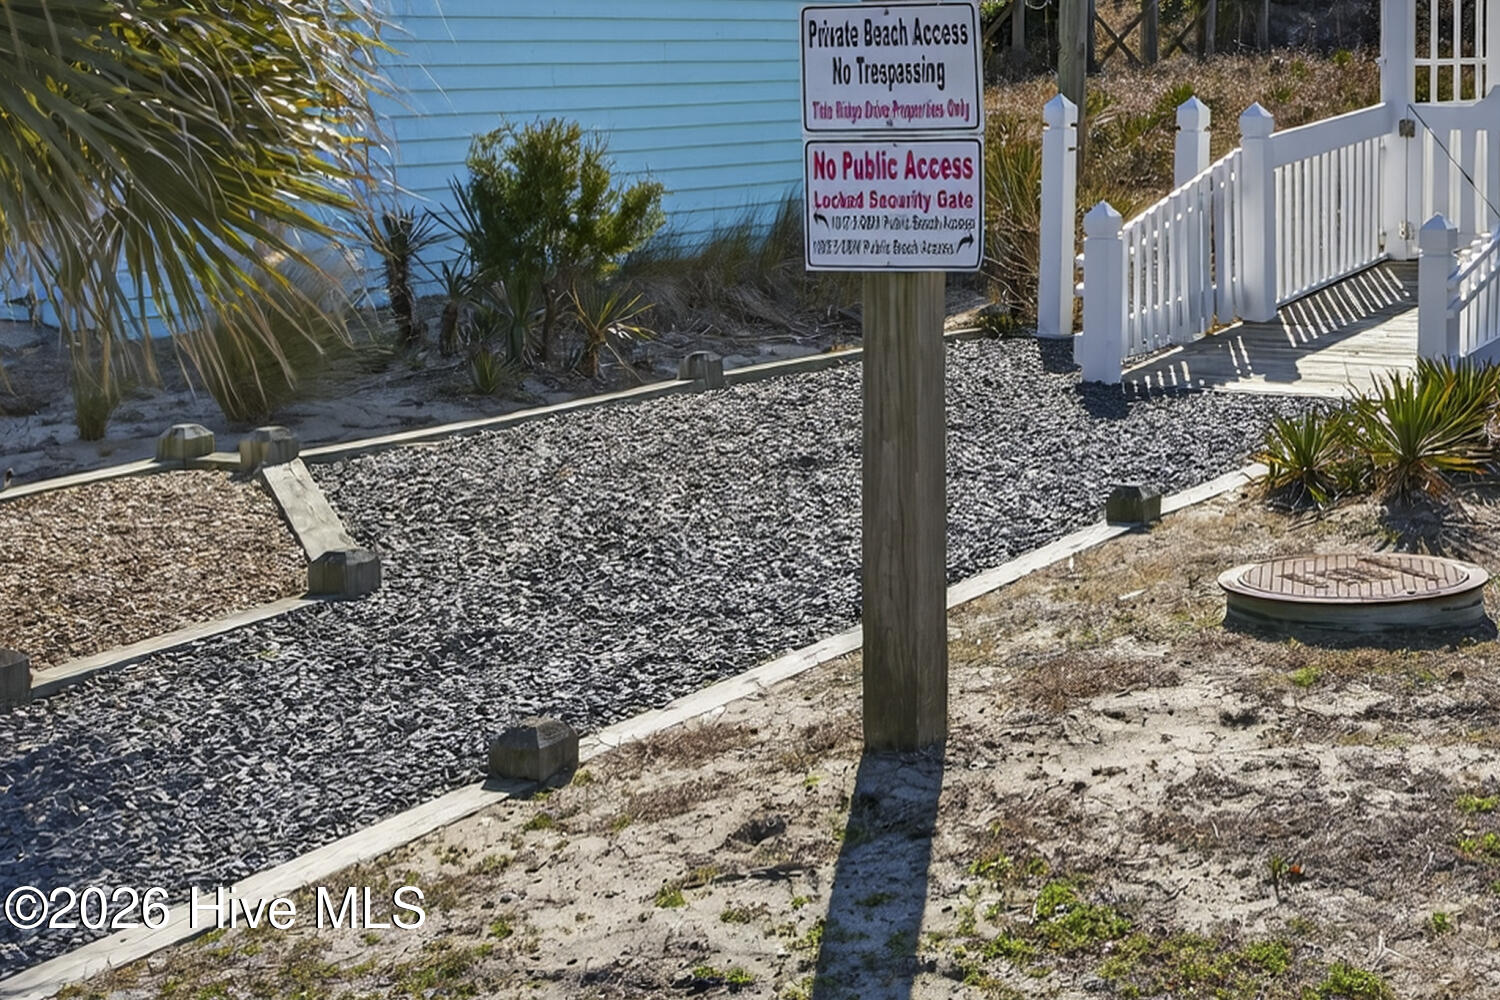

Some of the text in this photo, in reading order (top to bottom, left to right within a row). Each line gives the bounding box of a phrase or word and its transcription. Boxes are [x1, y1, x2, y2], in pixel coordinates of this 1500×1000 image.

[808, 17, 969, 48] Private Beach Access
[832, 55, 945, 91] No Trespassing
[865, 99, 890, 119] Drive
[892, 99, 944, 123] Properties
[946, 98, 970, 122] Only
[813, 149, 974, 180] No Public Access
[814, 189, 974, 214] Locked Security Gate
[863, 239, 890, 256] Public
[893, 239, 919, 255] Beach
